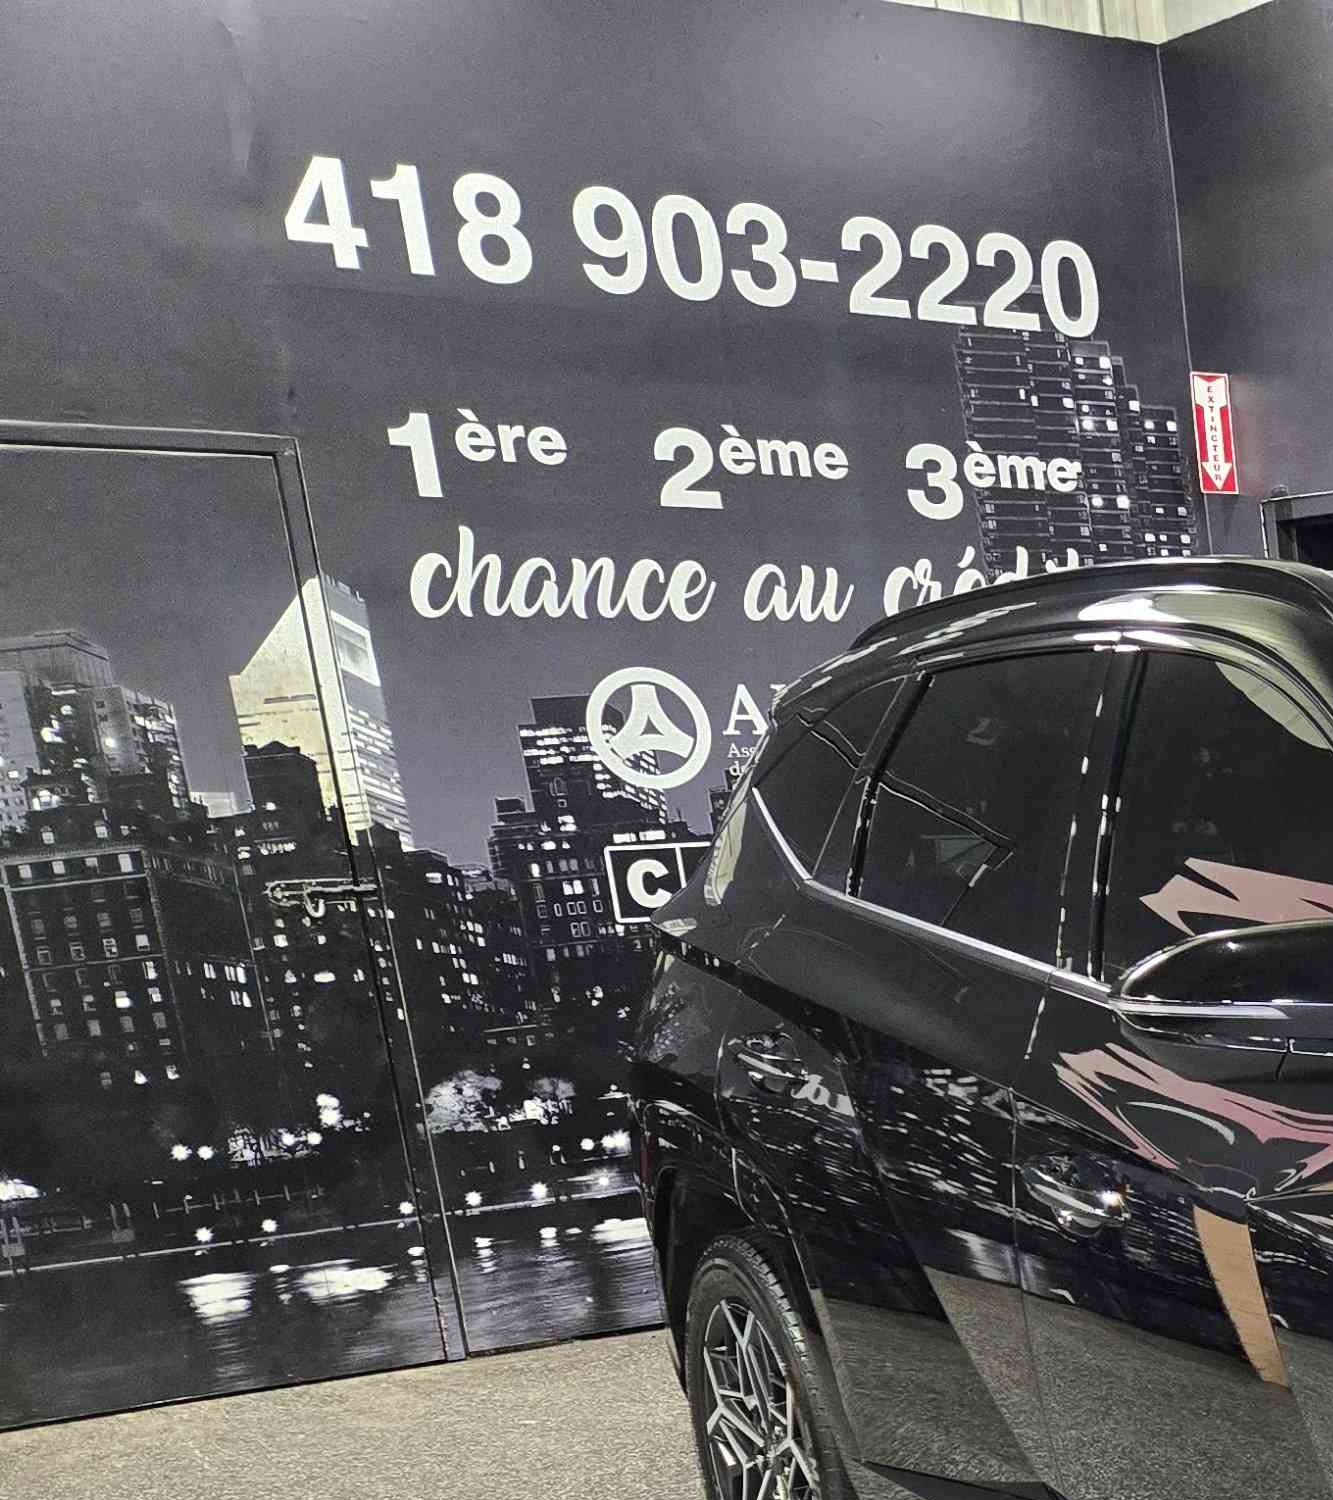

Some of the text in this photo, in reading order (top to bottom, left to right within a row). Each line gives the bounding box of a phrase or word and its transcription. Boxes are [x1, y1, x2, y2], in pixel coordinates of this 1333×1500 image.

[285, 155, 1099, 338] 418 903-2220
[387, 410, 1081, 521] 1ère 2ème 3ème
[1207, 386, 1222, 480] EXTINCTEUR
[410, 525, 717, 623] chance
[744, 564, 854, 623] au
